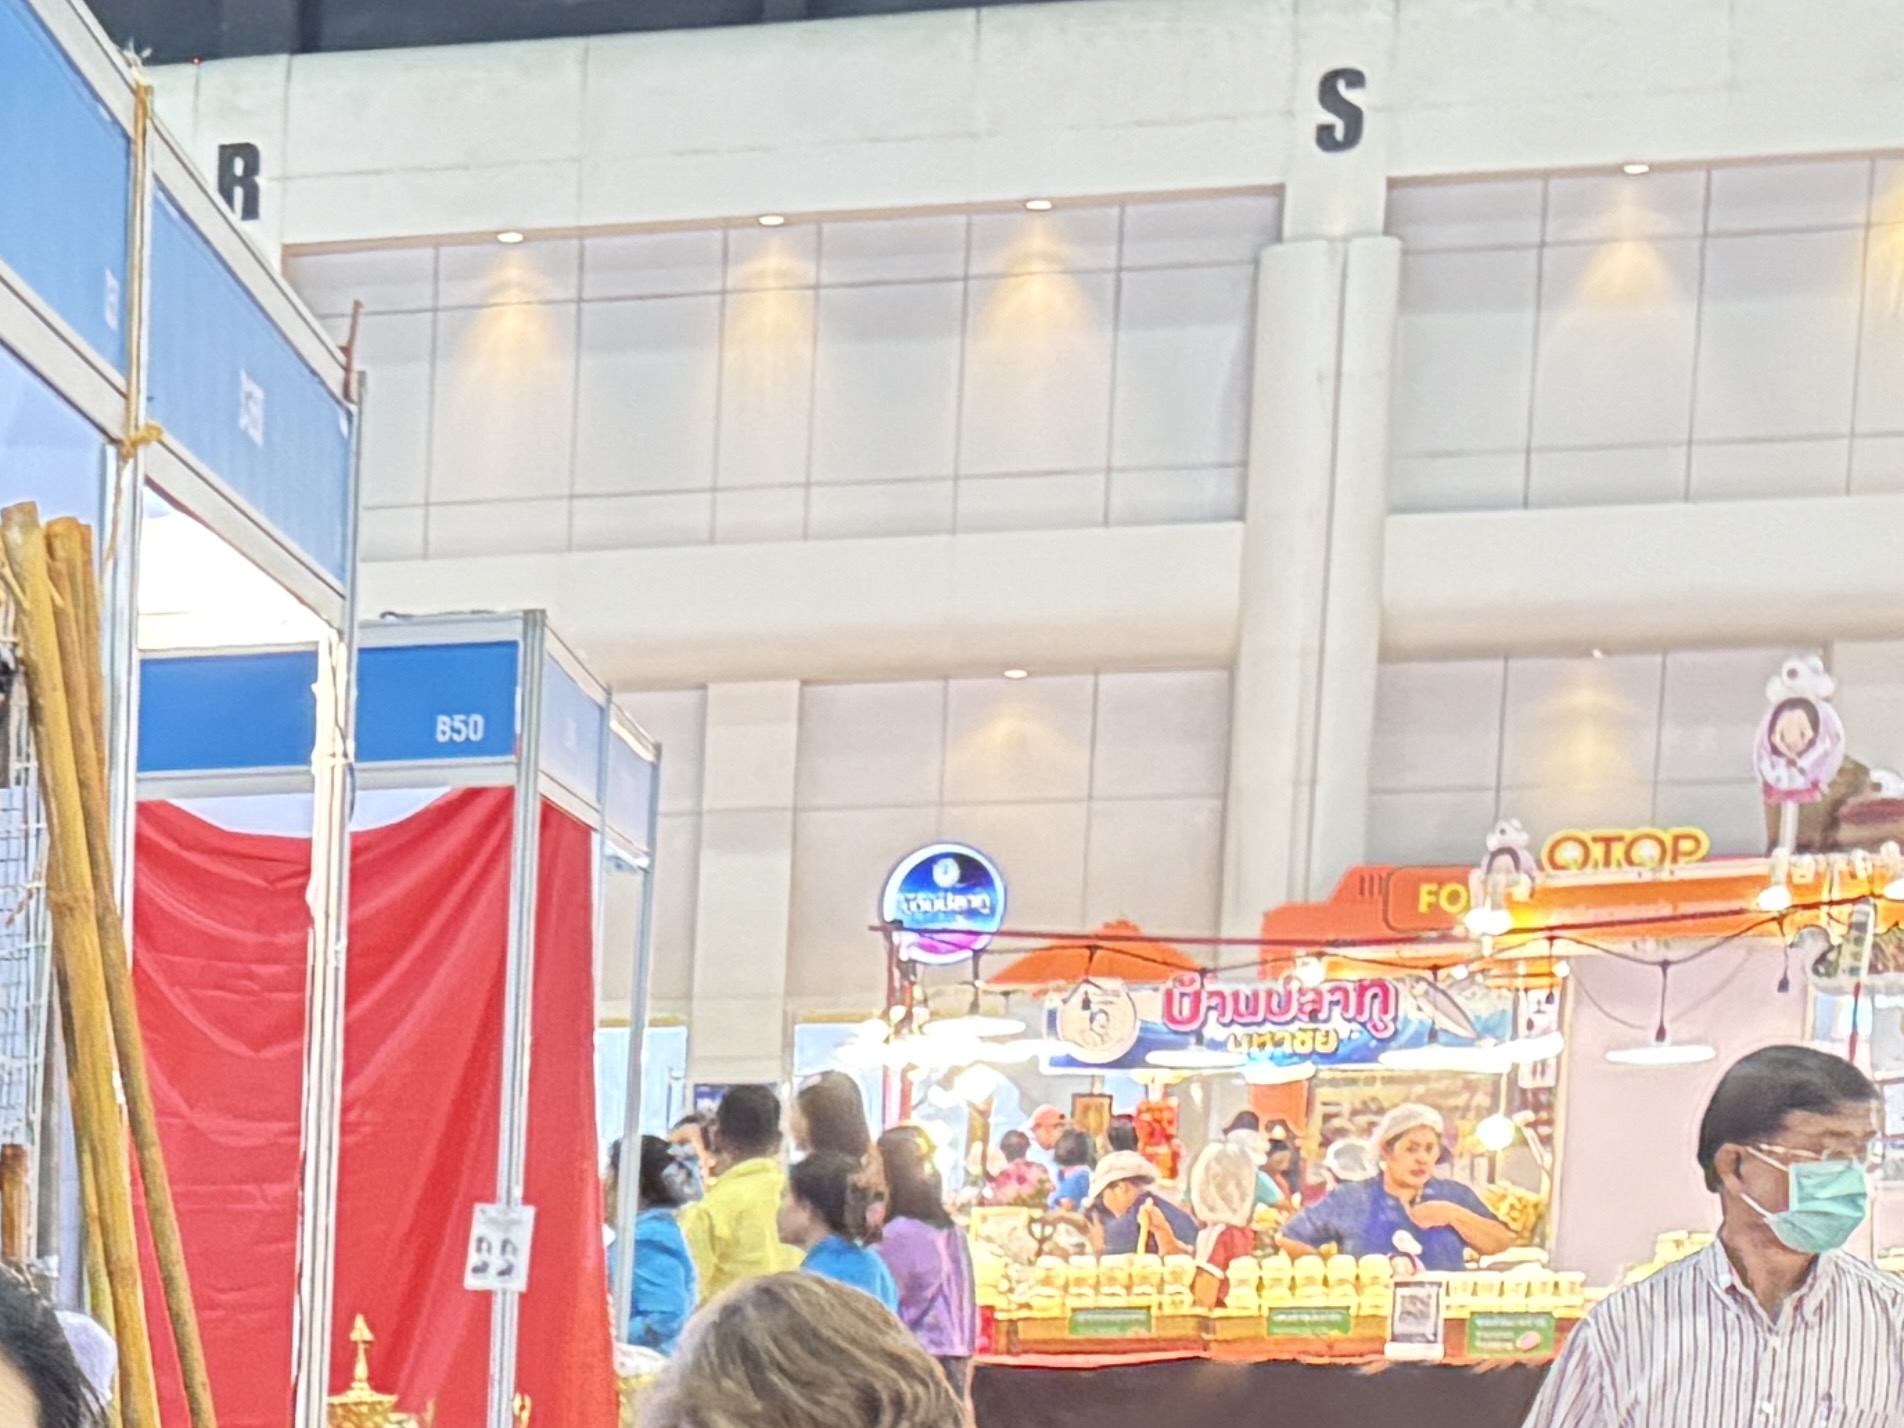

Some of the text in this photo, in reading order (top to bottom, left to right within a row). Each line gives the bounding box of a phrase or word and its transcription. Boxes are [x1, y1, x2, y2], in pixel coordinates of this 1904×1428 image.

[1314, 67, 1366, 153] S
[218, 142, 261, 221] R
[435, 713, 485, 743] B50
[1541, 826, 1710, 872] OTOP
[1417, 882, 1470, 915] FO
